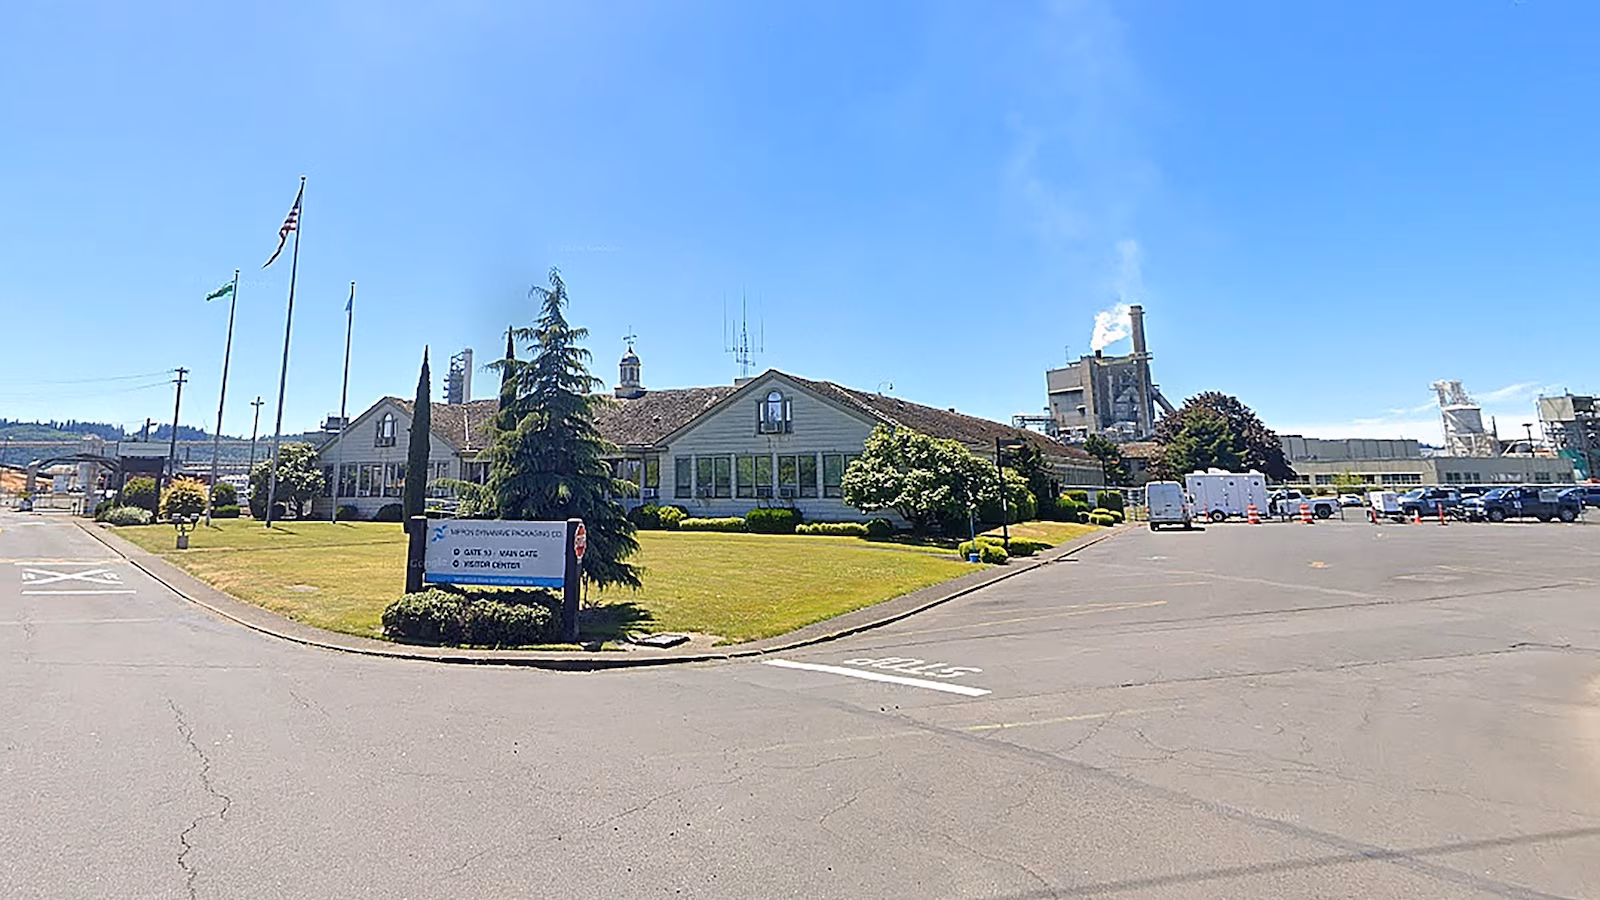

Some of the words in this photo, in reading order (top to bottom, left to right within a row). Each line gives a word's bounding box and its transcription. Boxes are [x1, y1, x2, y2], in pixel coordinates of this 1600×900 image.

[463, 548, 482, 556] GATE
[463, 560, 491, 568] VISITOR
[492, 561, 521, 569] CENTER
